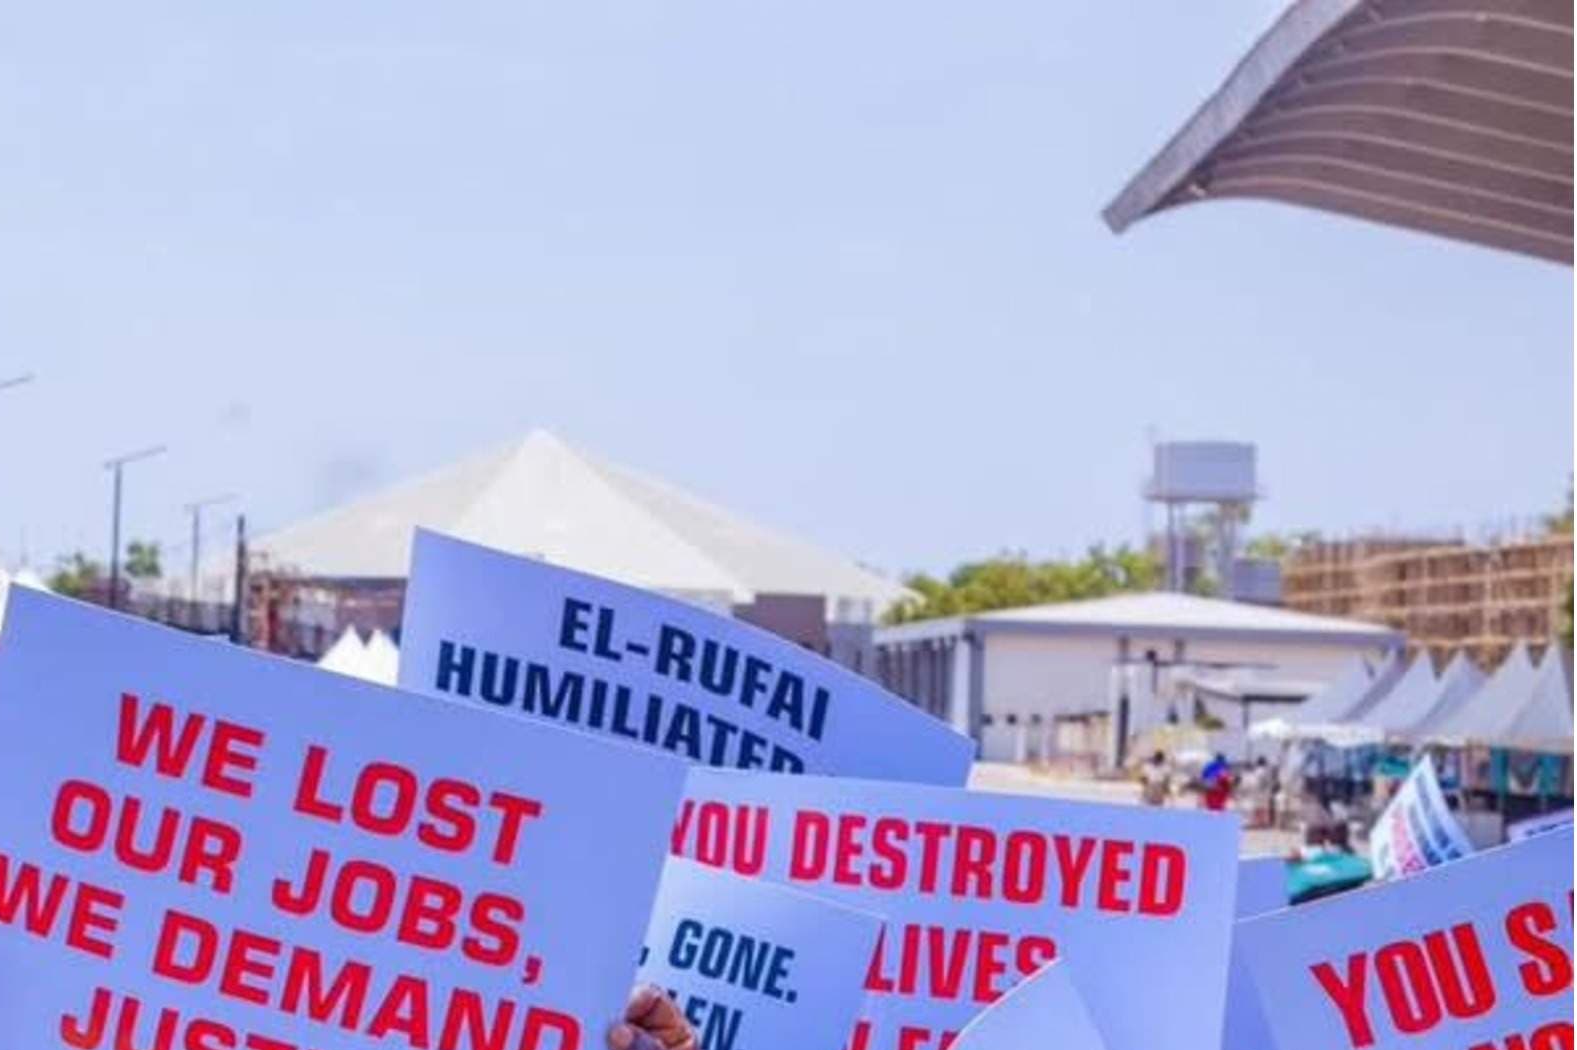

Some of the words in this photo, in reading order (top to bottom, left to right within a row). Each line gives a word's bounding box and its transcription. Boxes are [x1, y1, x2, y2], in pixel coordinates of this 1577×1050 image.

[558, 597, 832, 743] EL-RUFAI
[115, 692, 265, 799] WE
[294, 745, 543, 867] LOST
[50, 778, 243, 894] OUR
[271, 850, 543, 986] JOBS,
[789, 808, 1188, 918] DESTROYED
[668, 917, 797, 1003] GONE.
[1309, 923, 1498, 1049] YOU
[1505, 890, 1574, 998] S
